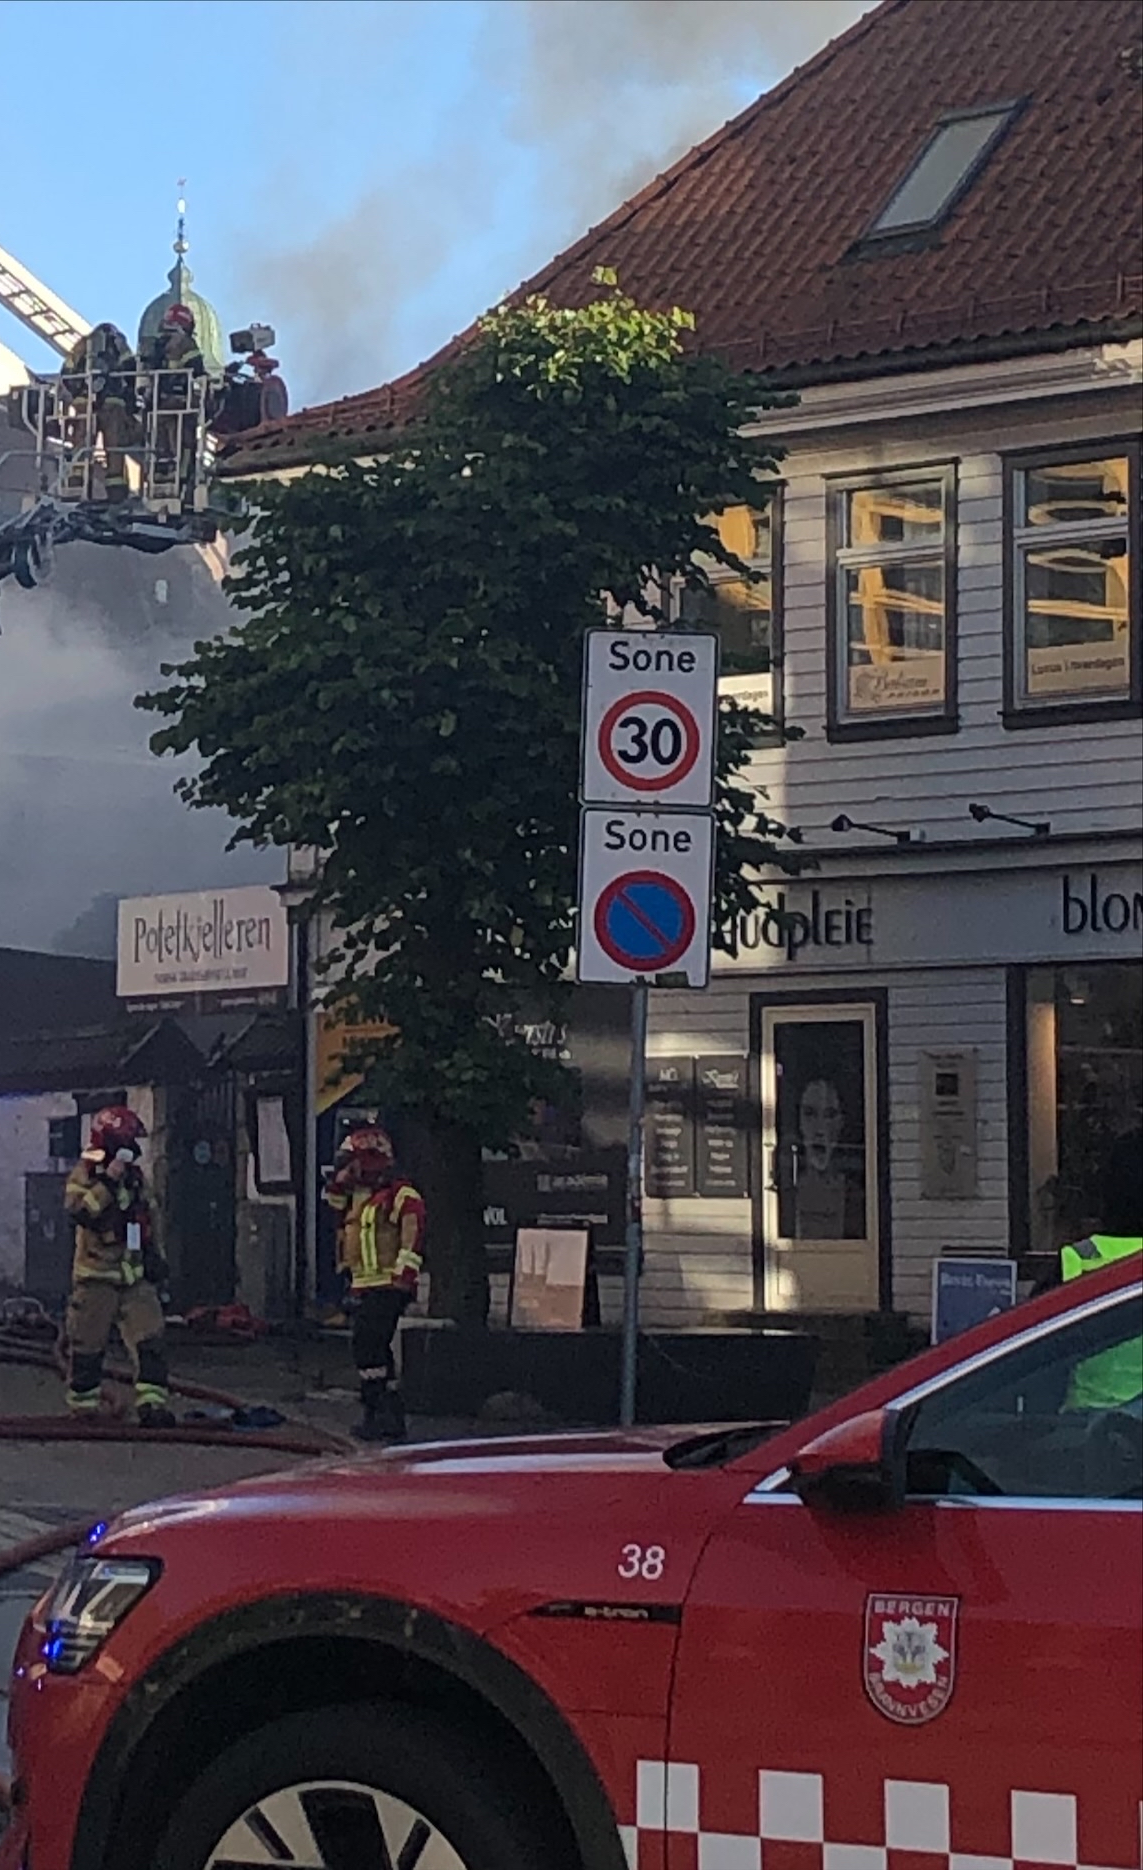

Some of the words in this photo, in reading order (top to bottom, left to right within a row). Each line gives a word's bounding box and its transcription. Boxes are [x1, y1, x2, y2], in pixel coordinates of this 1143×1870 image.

[608, 640, 697, 673] Sone
[617, 716, 682, 766] 30
[604, 819, 693, 852] Sone
[134, 898, 271, 963] Potetkjelleren
[618, 1543, 666, 1581] 38
[873, 1599, 950, 1617] BERGEN
